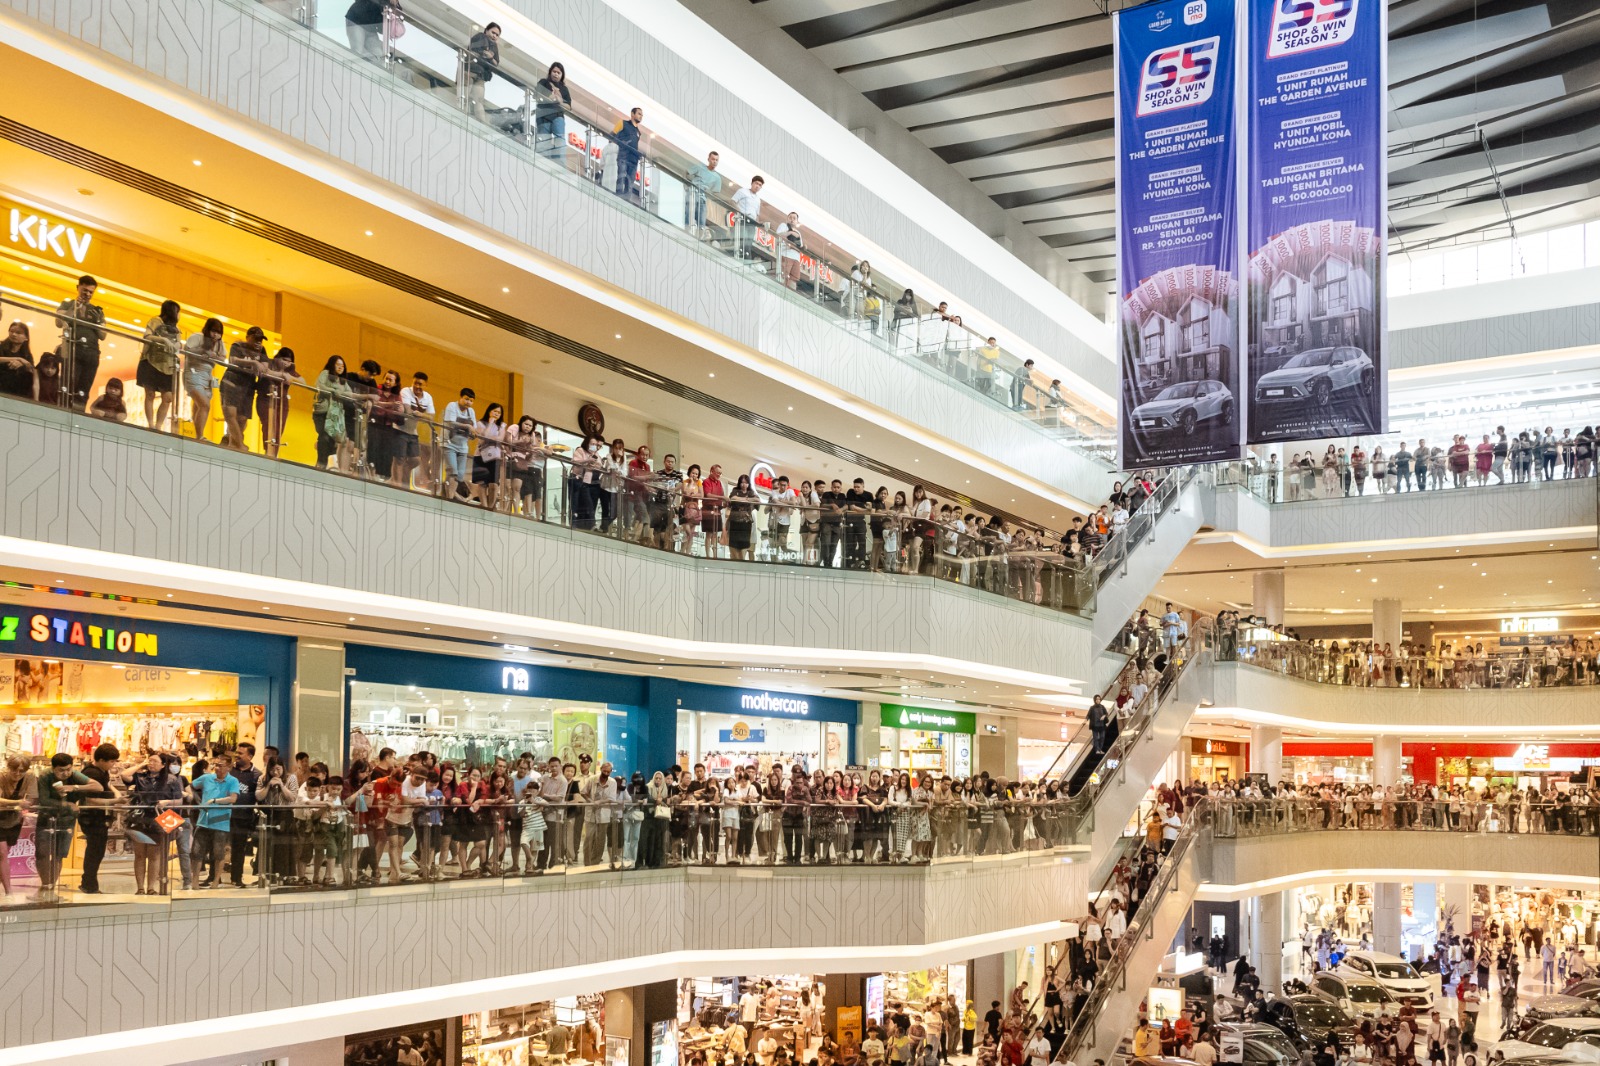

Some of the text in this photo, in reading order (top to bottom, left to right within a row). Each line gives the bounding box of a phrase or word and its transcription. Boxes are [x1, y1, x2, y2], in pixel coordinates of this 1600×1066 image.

[1188, 4, 1203, 15] BRI
[1277, 20, 1346, 42] SHOP & WIN
[1284, 34, 1328, 49] SEASON
[1318, 64, 1346, 73] PLATINUM
[1284, 81, 1307, 91] UNIT
[1311, 73, 1348, 86] RUMAH
[1145, 90, 1171, 101] SHOP
[1185, 82, 1205, 92] WIN
[1259, 96, 1277, 106] THE
[1281, 88, 1321, 102] GARDEN
[1325, 78, 1367, 93] AVENUE
[1151, 94, 1190, 108] SEASON
[1181, 122, 1206, 130] PLATINUM
[1287, 127, 1310, 137] UNIT
[1314, 121, 1345, 133] MOBIL
[1129, 151, 1145, 160] THE
[1148, 144, 1184, 156] GARDEN
[1188, 135, 1224, 149] AVENUE
[1152, 137, 1172, 147] UNIT
[1175, 130, 1207, 142] RUMAH
[1274, 135, 1319, 150] HYUNDAI
[1322, 129, 1351, 140] KONA
[1155, 179, 1175, 189] UNIT
[1178, 174, 1206, 185] MOBIL
[1262, 163, 1364, 187] TABUNGAN BRITAMA
[1143, 188, 1182, 200] HYUNDAI
[1186, 182, 1211, 192] KONA
[1293, 178, 1332, 191] SENILAI
[1272, 196, 1286, 204] RP.
[1289, 185, 1353, 202] 100.000.000
[1133, 213, 1222, 234] TABUNGAN BRITAMA
[1160, 227, 1195, 238] SENILAI
[1142, 242, 1154, 250] RP.
[1157, 232, 1213, 248] 100.000.000
[30, 614, 158, 656] STATION
[125, 669, 171, 681] carters
[742, 692, 808, 715] mothercare
[1513, 743, 1549, 758] ACE
